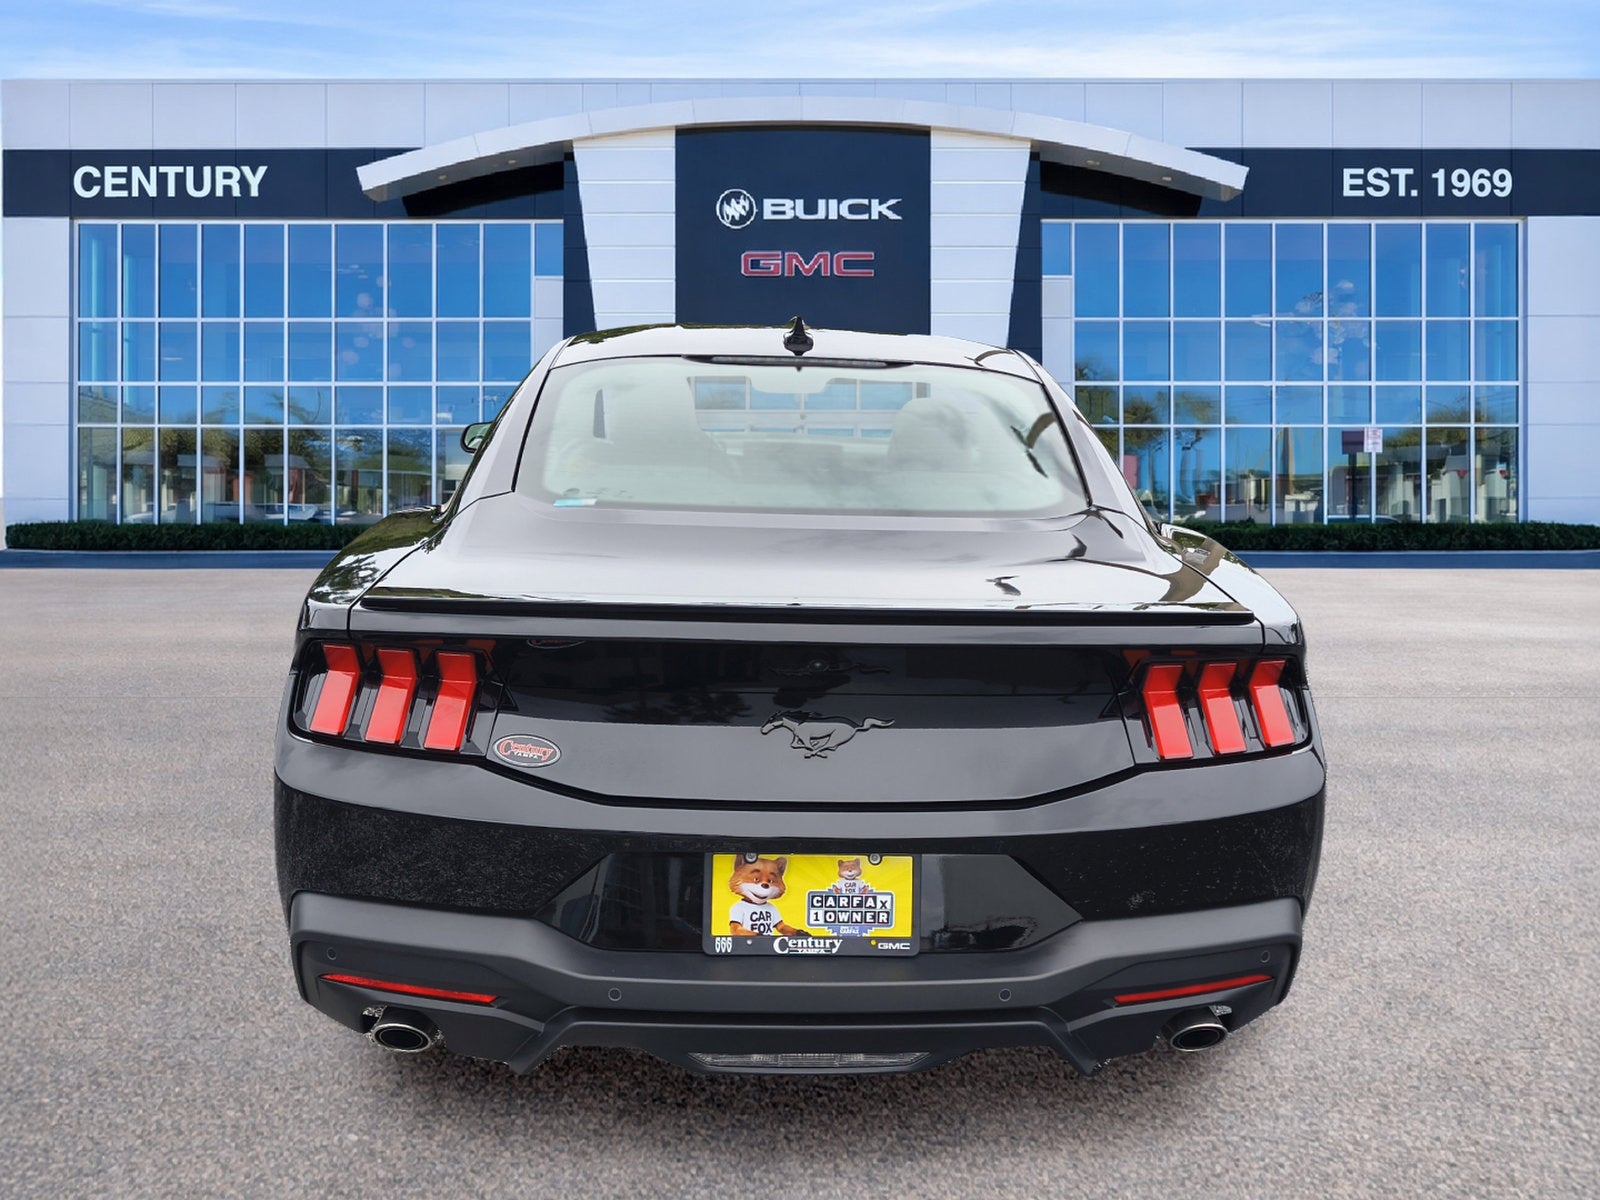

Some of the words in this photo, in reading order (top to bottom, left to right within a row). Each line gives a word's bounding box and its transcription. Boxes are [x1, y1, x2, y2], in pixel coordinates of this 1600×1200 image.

[73, 165, 268, 199] CENTURY
[1342, 167, 1418, 198] EST.
[1431, 167, 1513, 198] 1969
[762, 198, 903, 220] BUICK
[741, 250, 875, 277] GMC
[499, 740, 554, 761] Century
[812, 897, 888, 909] CARFAX
[750, 910, 772, 922] CAR
[813, 912, 820, 921] 1
[825, 912, 889, 923] OWNER
[750, 923, 773, 934] FOX
[773, 936, 843, 954] Century
[878, 942, 911, 950] GMC
